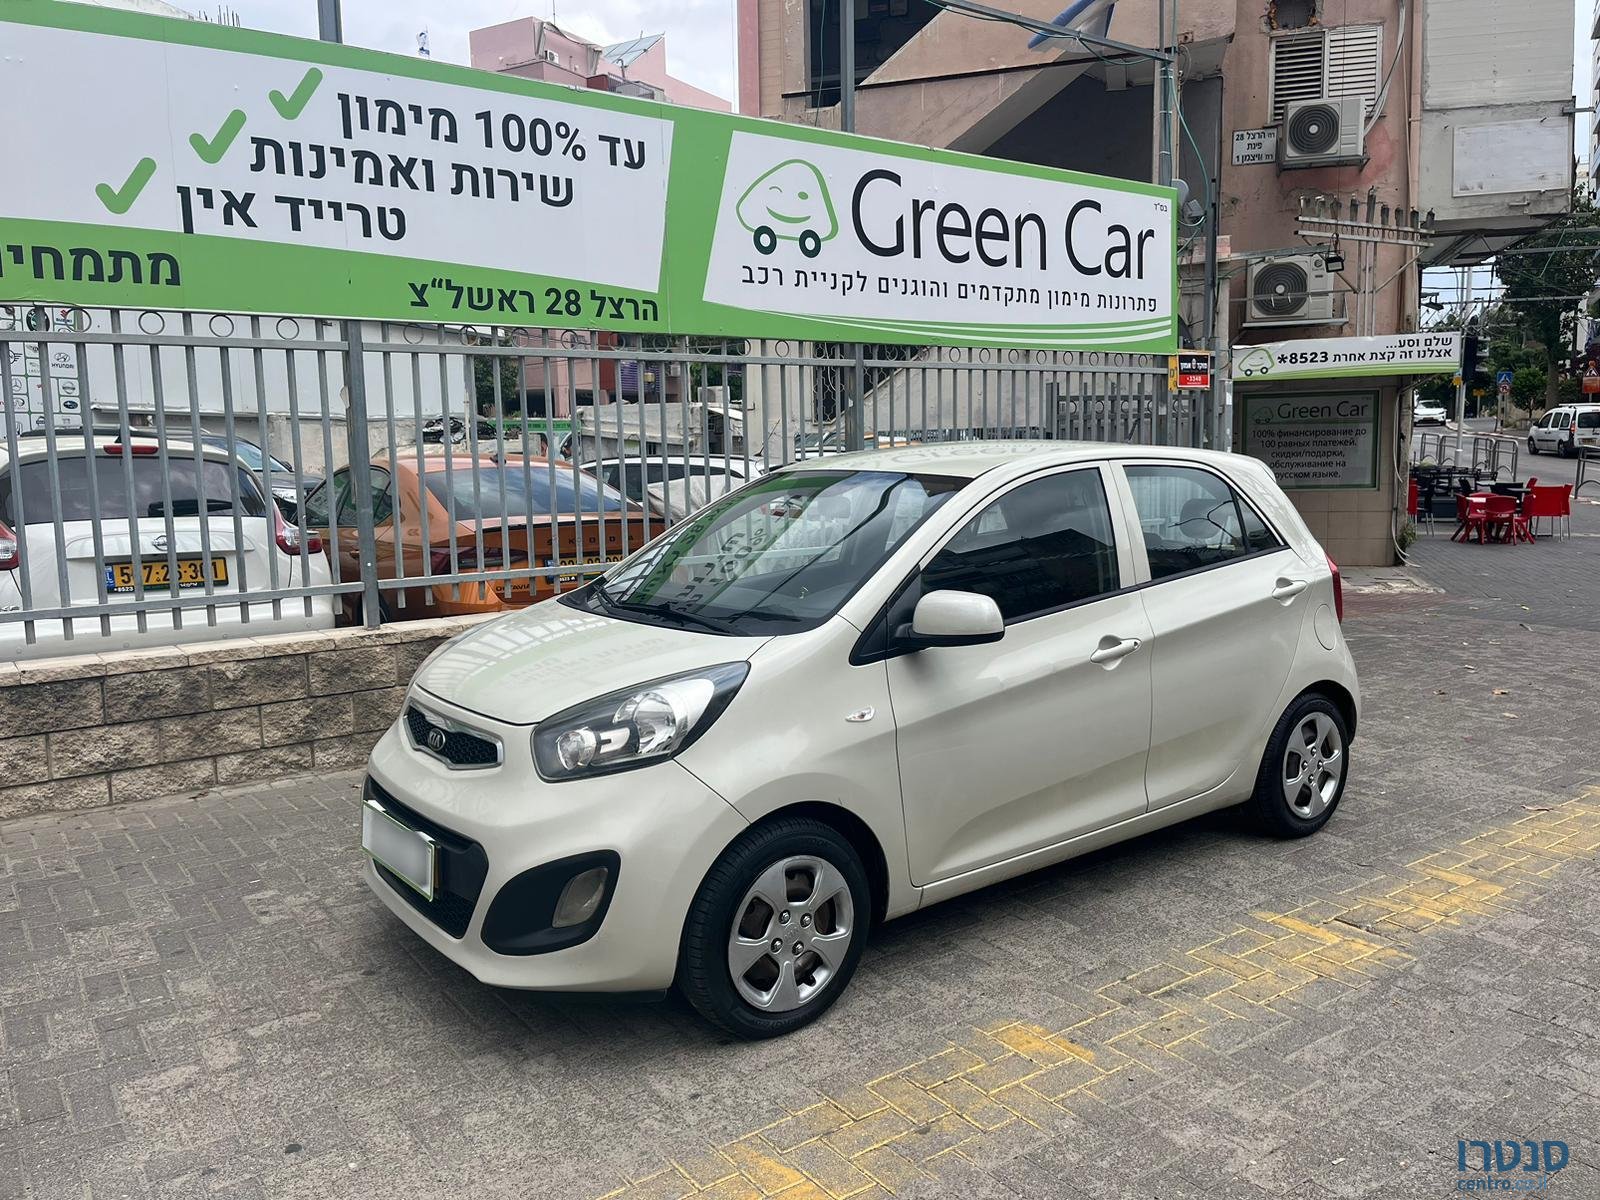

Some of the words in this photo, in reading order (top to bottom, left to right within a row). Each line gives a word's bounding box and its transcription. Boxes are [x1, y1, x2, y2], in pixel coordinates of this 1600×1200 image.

[337, 92, 458, 144] מימון
[475, 110, 586, 162] 100%
[1235, 133, 1244, 141] 28
[1246, 131, 1266, 140] הרצל
[598, 134, 646, 170] עד
[1247, 142, 1262, 150] פינת
[249, 136, 435, 193] ואמינות
[450, 162, 574, 208] שירות
[177, 185, 258, 234] אין
[274, 195, 406, 241] טרייד
[851, 169, 1047, 271] Green
[1064, 199, 1155, 280] Car
[0, 244, 181, 287] מתמחי
[741, 265, 783, 286] רכב
[794, 269, 868, 296] לקניית
[878, 276, 948, 298] והוגנים
[544, 287, 582, 317] 28
[957, 283, 1040, 307] מתקדמים
[1047, 290, 1090, 310] מימון
[1097, 293, 1157, 312] פתרונות
[590, 289, 659, 322] הרצל
[1386, 339, 1419, 348] וסע...
[1424, 336, 1452, 347] שלם
[1333, 352, 1365, 363] אחרת
[1370, 351, 1396, 362] קצת
[1400, 351, 1414, 359] זה
[1418, 348, 1452, 359] אצלנו
[1277, 403, 1331, 418] Green
[1336, 401, 1368, 417] Car
[1252, 429, 1275, 439] 100%
[1277, 428, 1353, 439] финансирование
[1355, 428, 1367, 437] до
[1261, 440, 1276, 448] 100
[1278, 440, 1309, 449] равных
[1270, 460, 1333, 470] обслуживание
[1274, 470, 1310, 480] русском
